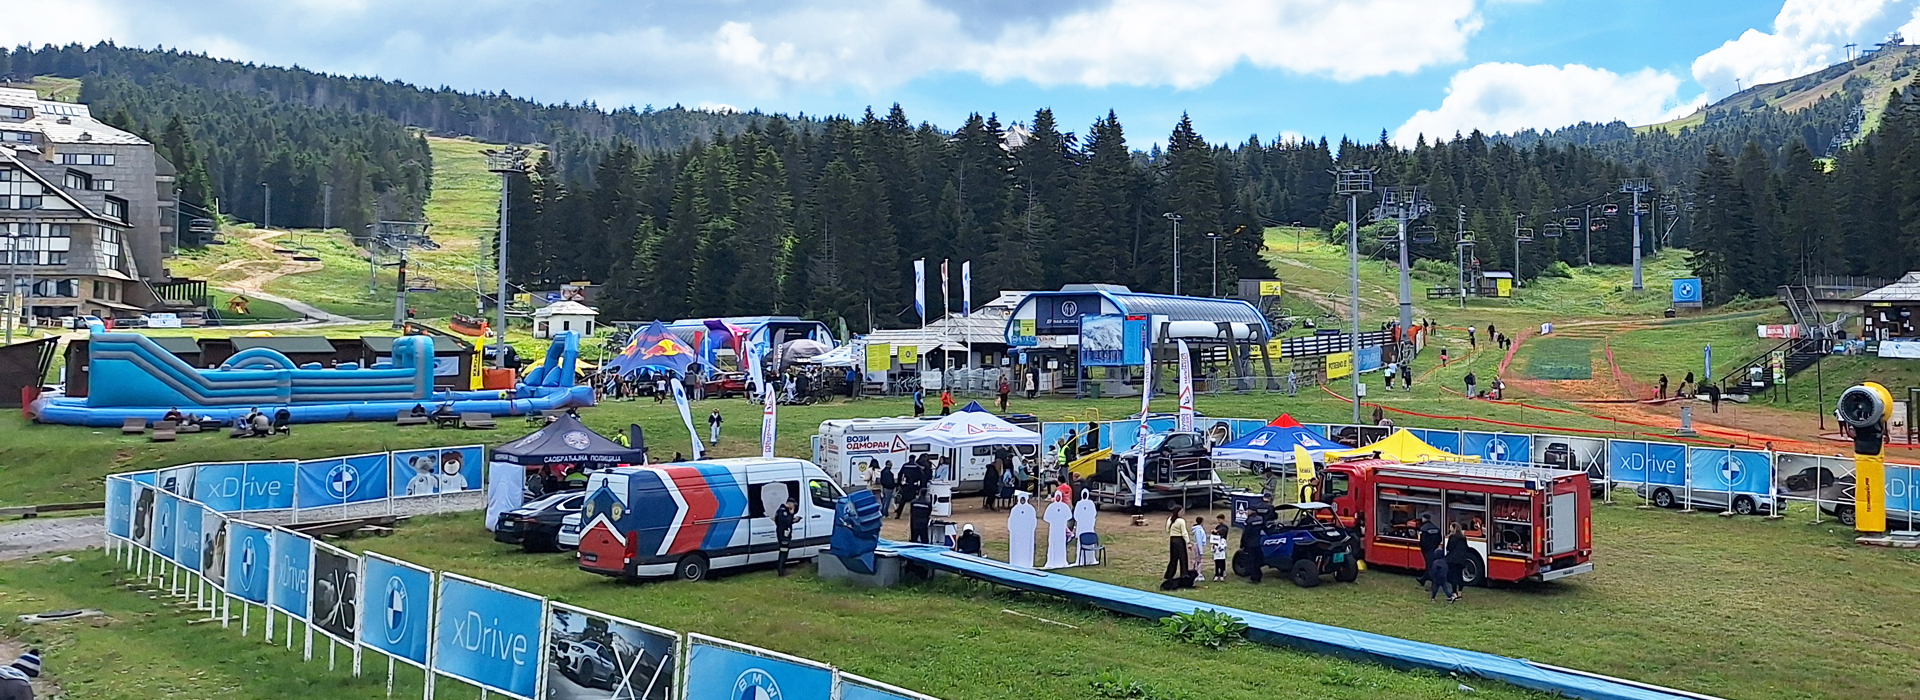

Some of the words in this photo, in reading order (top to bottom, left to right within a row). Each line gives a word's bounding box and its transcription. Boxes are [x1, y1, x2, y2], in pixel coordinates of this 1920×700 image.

[846, 435, 870, 443] ВОЗИ
[846, 441, 890, 450] ОДМОРАН
[543, 454, 588, 463] САОБРАЋАЈНА
[589, 454, 621, 462] ПОЛИЦИЈА
[1620, 452, 1677, 474] xDrive
[207, 476, 281, 498] xDrive
[1263, 537, 1287, 545] RZR
[278, 554, 307, 594] xDrive
[331, 569, 357, 633] X3
[452, 610, 527, 666] xDrive
[738, 672, 777, 698] BMW
